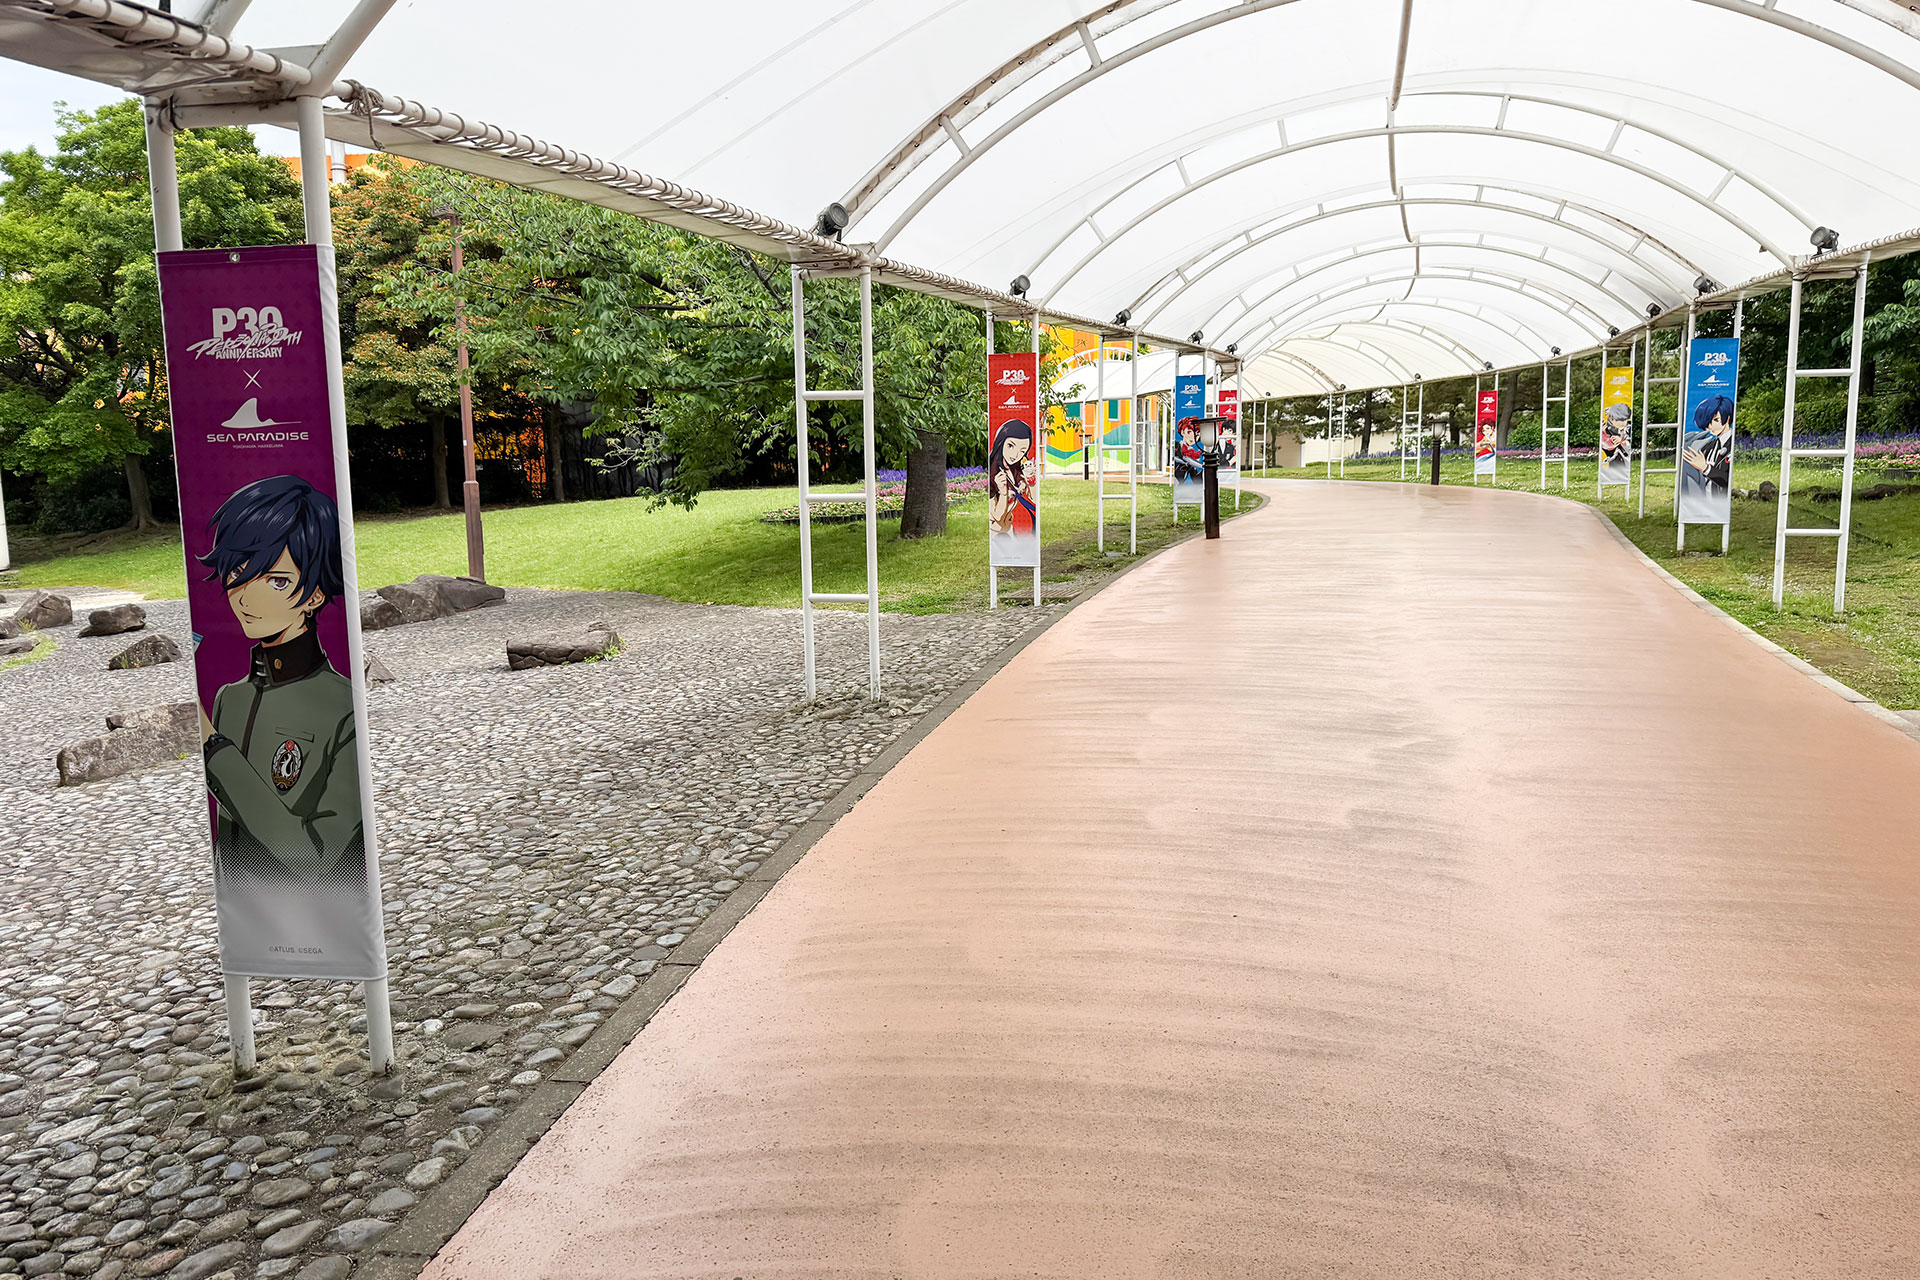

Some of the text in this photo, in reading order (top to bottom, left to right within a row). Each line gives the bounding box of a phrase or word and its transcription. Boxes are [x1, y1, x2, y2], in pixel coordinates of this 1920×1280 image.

[212, 306, 284, 341] P30
[215, 347, 282, 360] ANNIVERSARY
[206, 431, 309, 443] SEA PARADISE
